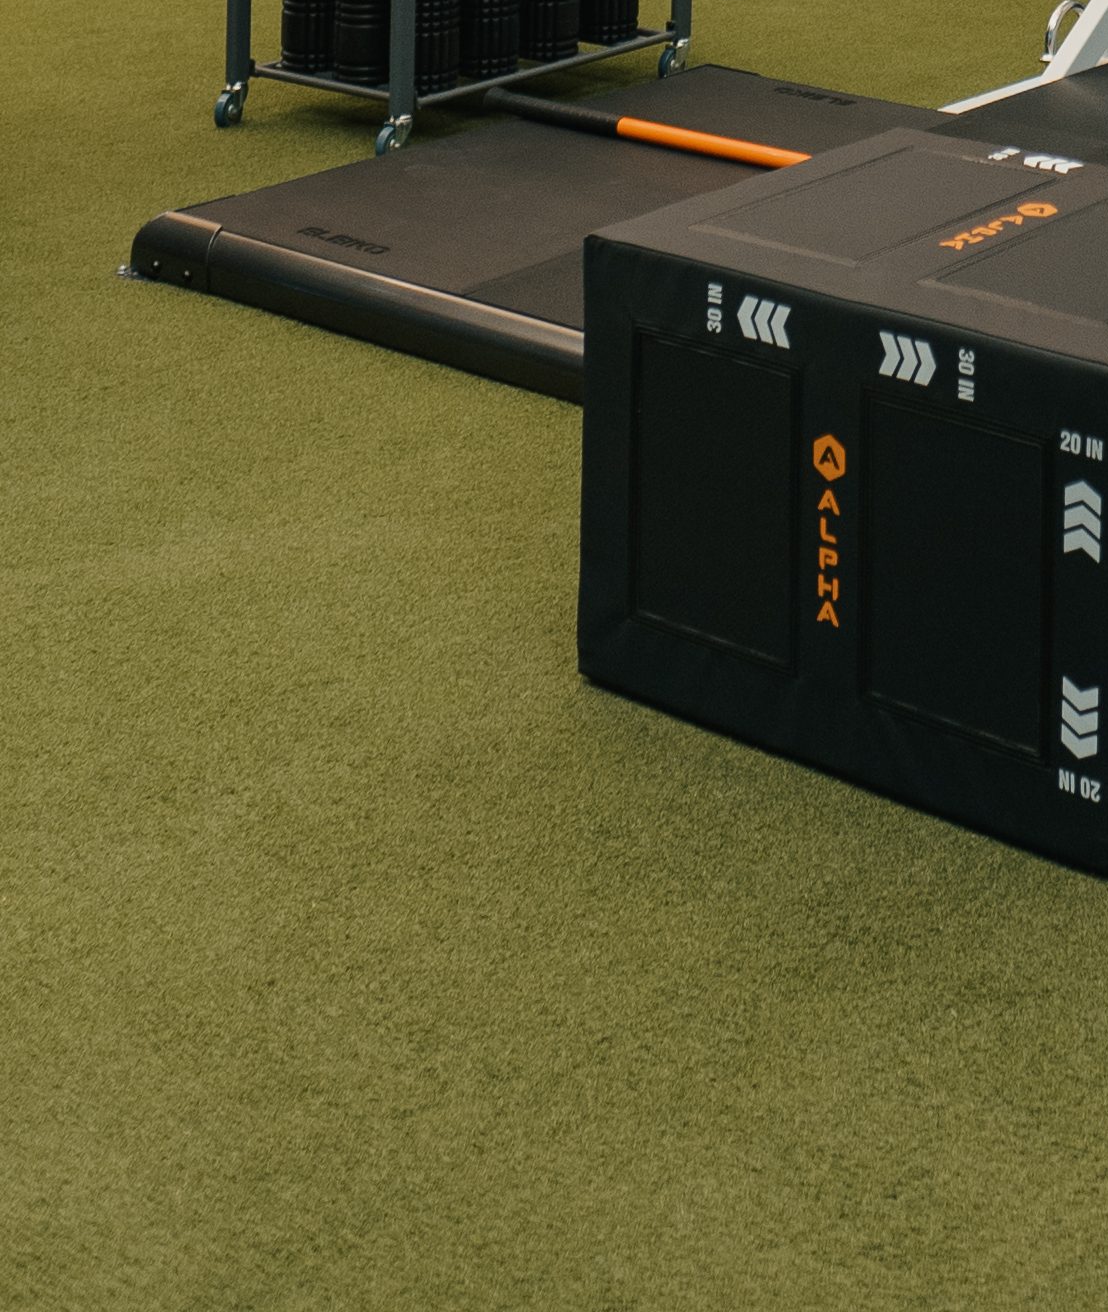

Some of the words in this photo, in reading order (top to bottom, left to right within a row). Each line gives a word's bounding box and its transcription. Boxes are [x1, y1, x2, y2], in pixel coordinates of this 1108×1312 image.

[938, 213, 1025, 251] ALPHA
[707, 282, 724, 305] IN
[706, 306, 723, 334] 30
[957, 347, 976, 377] 30
[957, 378, 976, 403] IN
[1059, 430, 1083, 455] 20
[1085, 437, 1104, 462] IN
[816, 487, 841, 628] ALPHA
[1058, 768, 1076, 795] IN
[1079, 777, 1101, 803] 20
